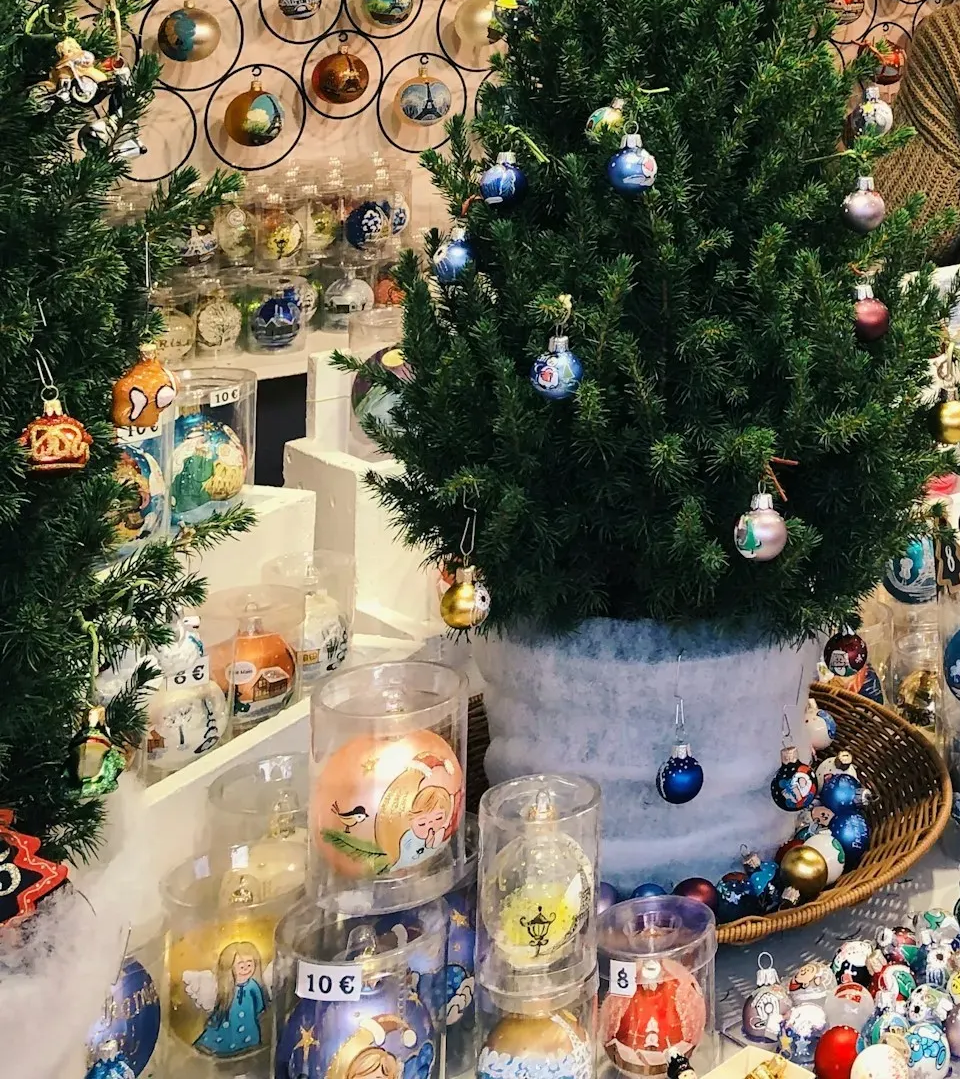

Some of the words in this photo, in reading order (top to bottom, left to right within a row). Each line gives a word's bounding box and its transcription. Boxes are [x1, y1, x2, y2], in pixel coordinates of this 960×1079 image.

[215, 392, 229, 403] 10
[231, 389, 238, 399] €
[945, 545, 955, 572] 8
[192, 664, 205, 681] €
[306, 973, 333, 994] 10
[339, 975, 355, 995] €
